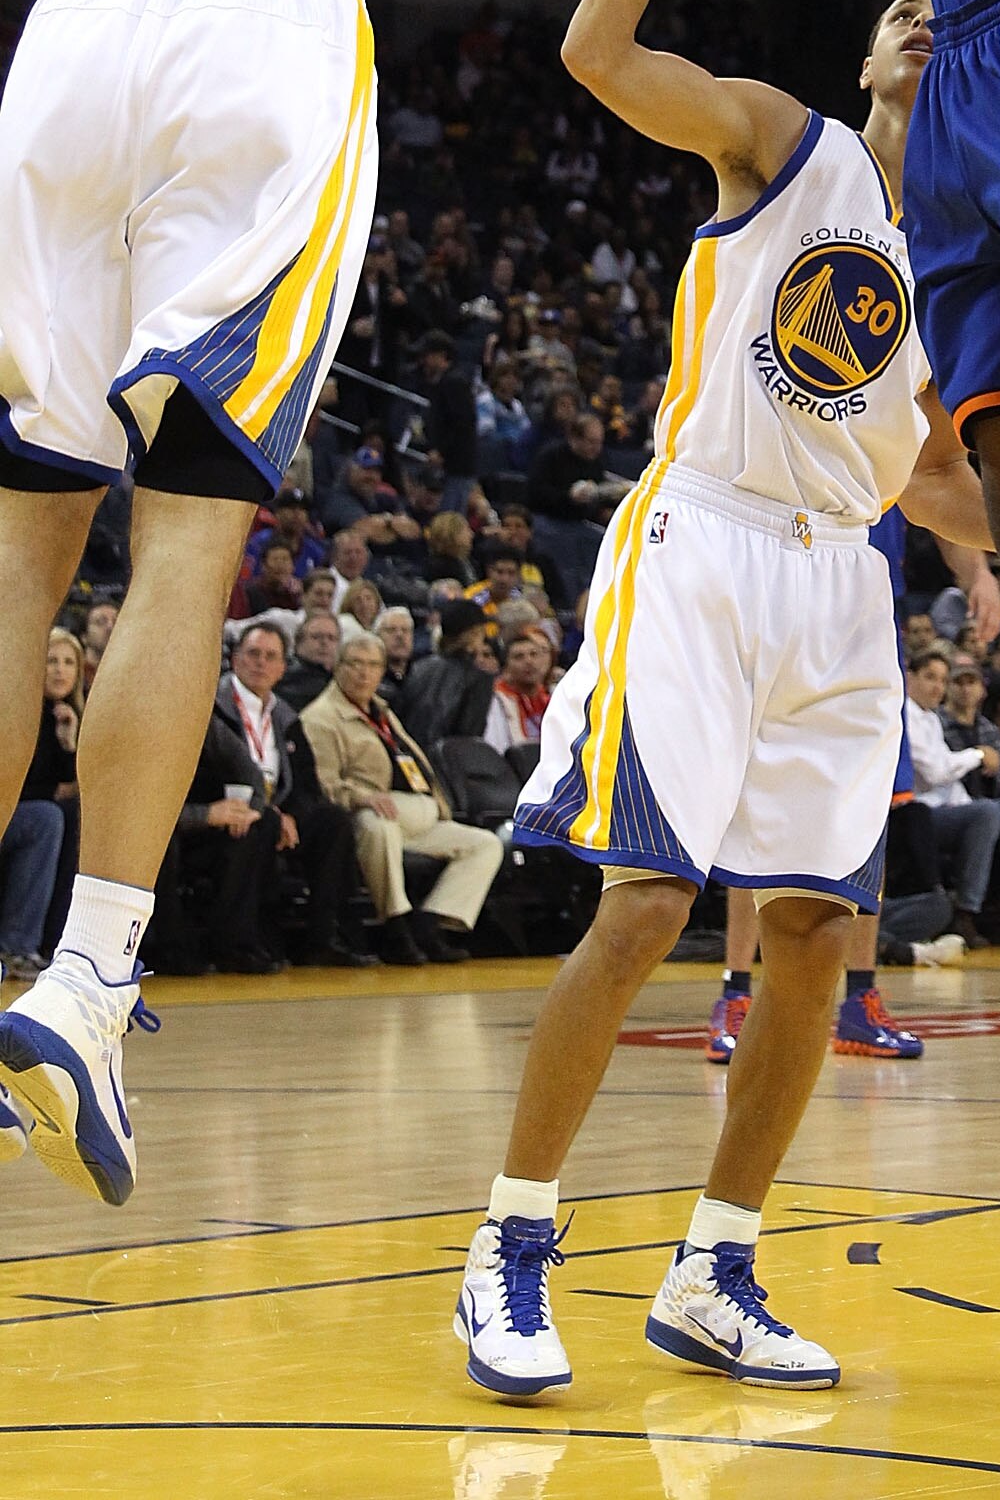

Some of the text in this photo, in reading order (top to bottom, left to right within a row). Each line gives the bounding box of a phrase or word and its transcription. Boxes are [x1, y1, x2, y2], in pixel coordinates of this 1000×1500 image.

[800, 227, 892, 253] GOLDEN
[844, 286, 897, 336] 30
[750, 332, 867, 422] WARRIORS
